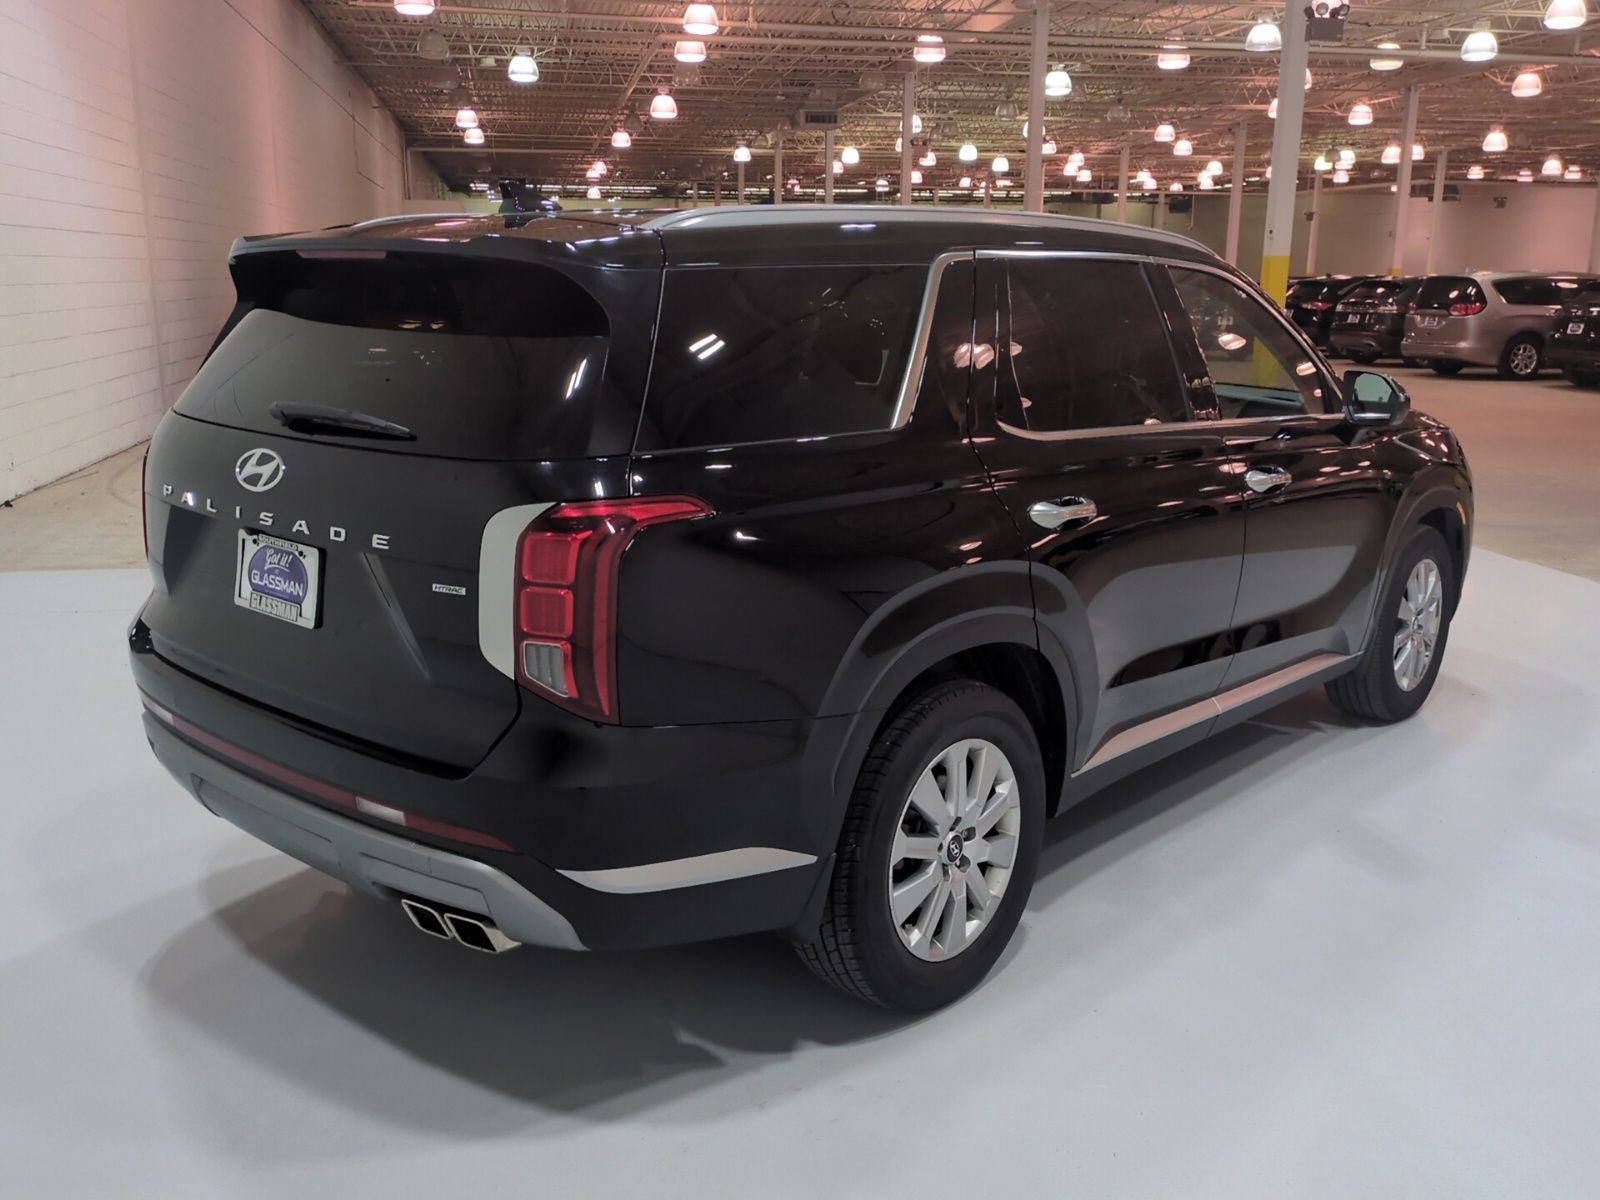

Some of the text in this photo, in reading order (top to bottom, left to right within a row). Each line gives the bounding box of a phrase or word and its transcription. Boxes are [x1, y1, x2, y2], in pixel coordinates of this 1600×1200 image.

[163, 484, 391, 550] PALISADE
[258, 535, 299, 552] SOUTHFIELD
[251, 570, 303, 596] GLASSMAN
[251, 594, 298, 621] GLASSMAN
